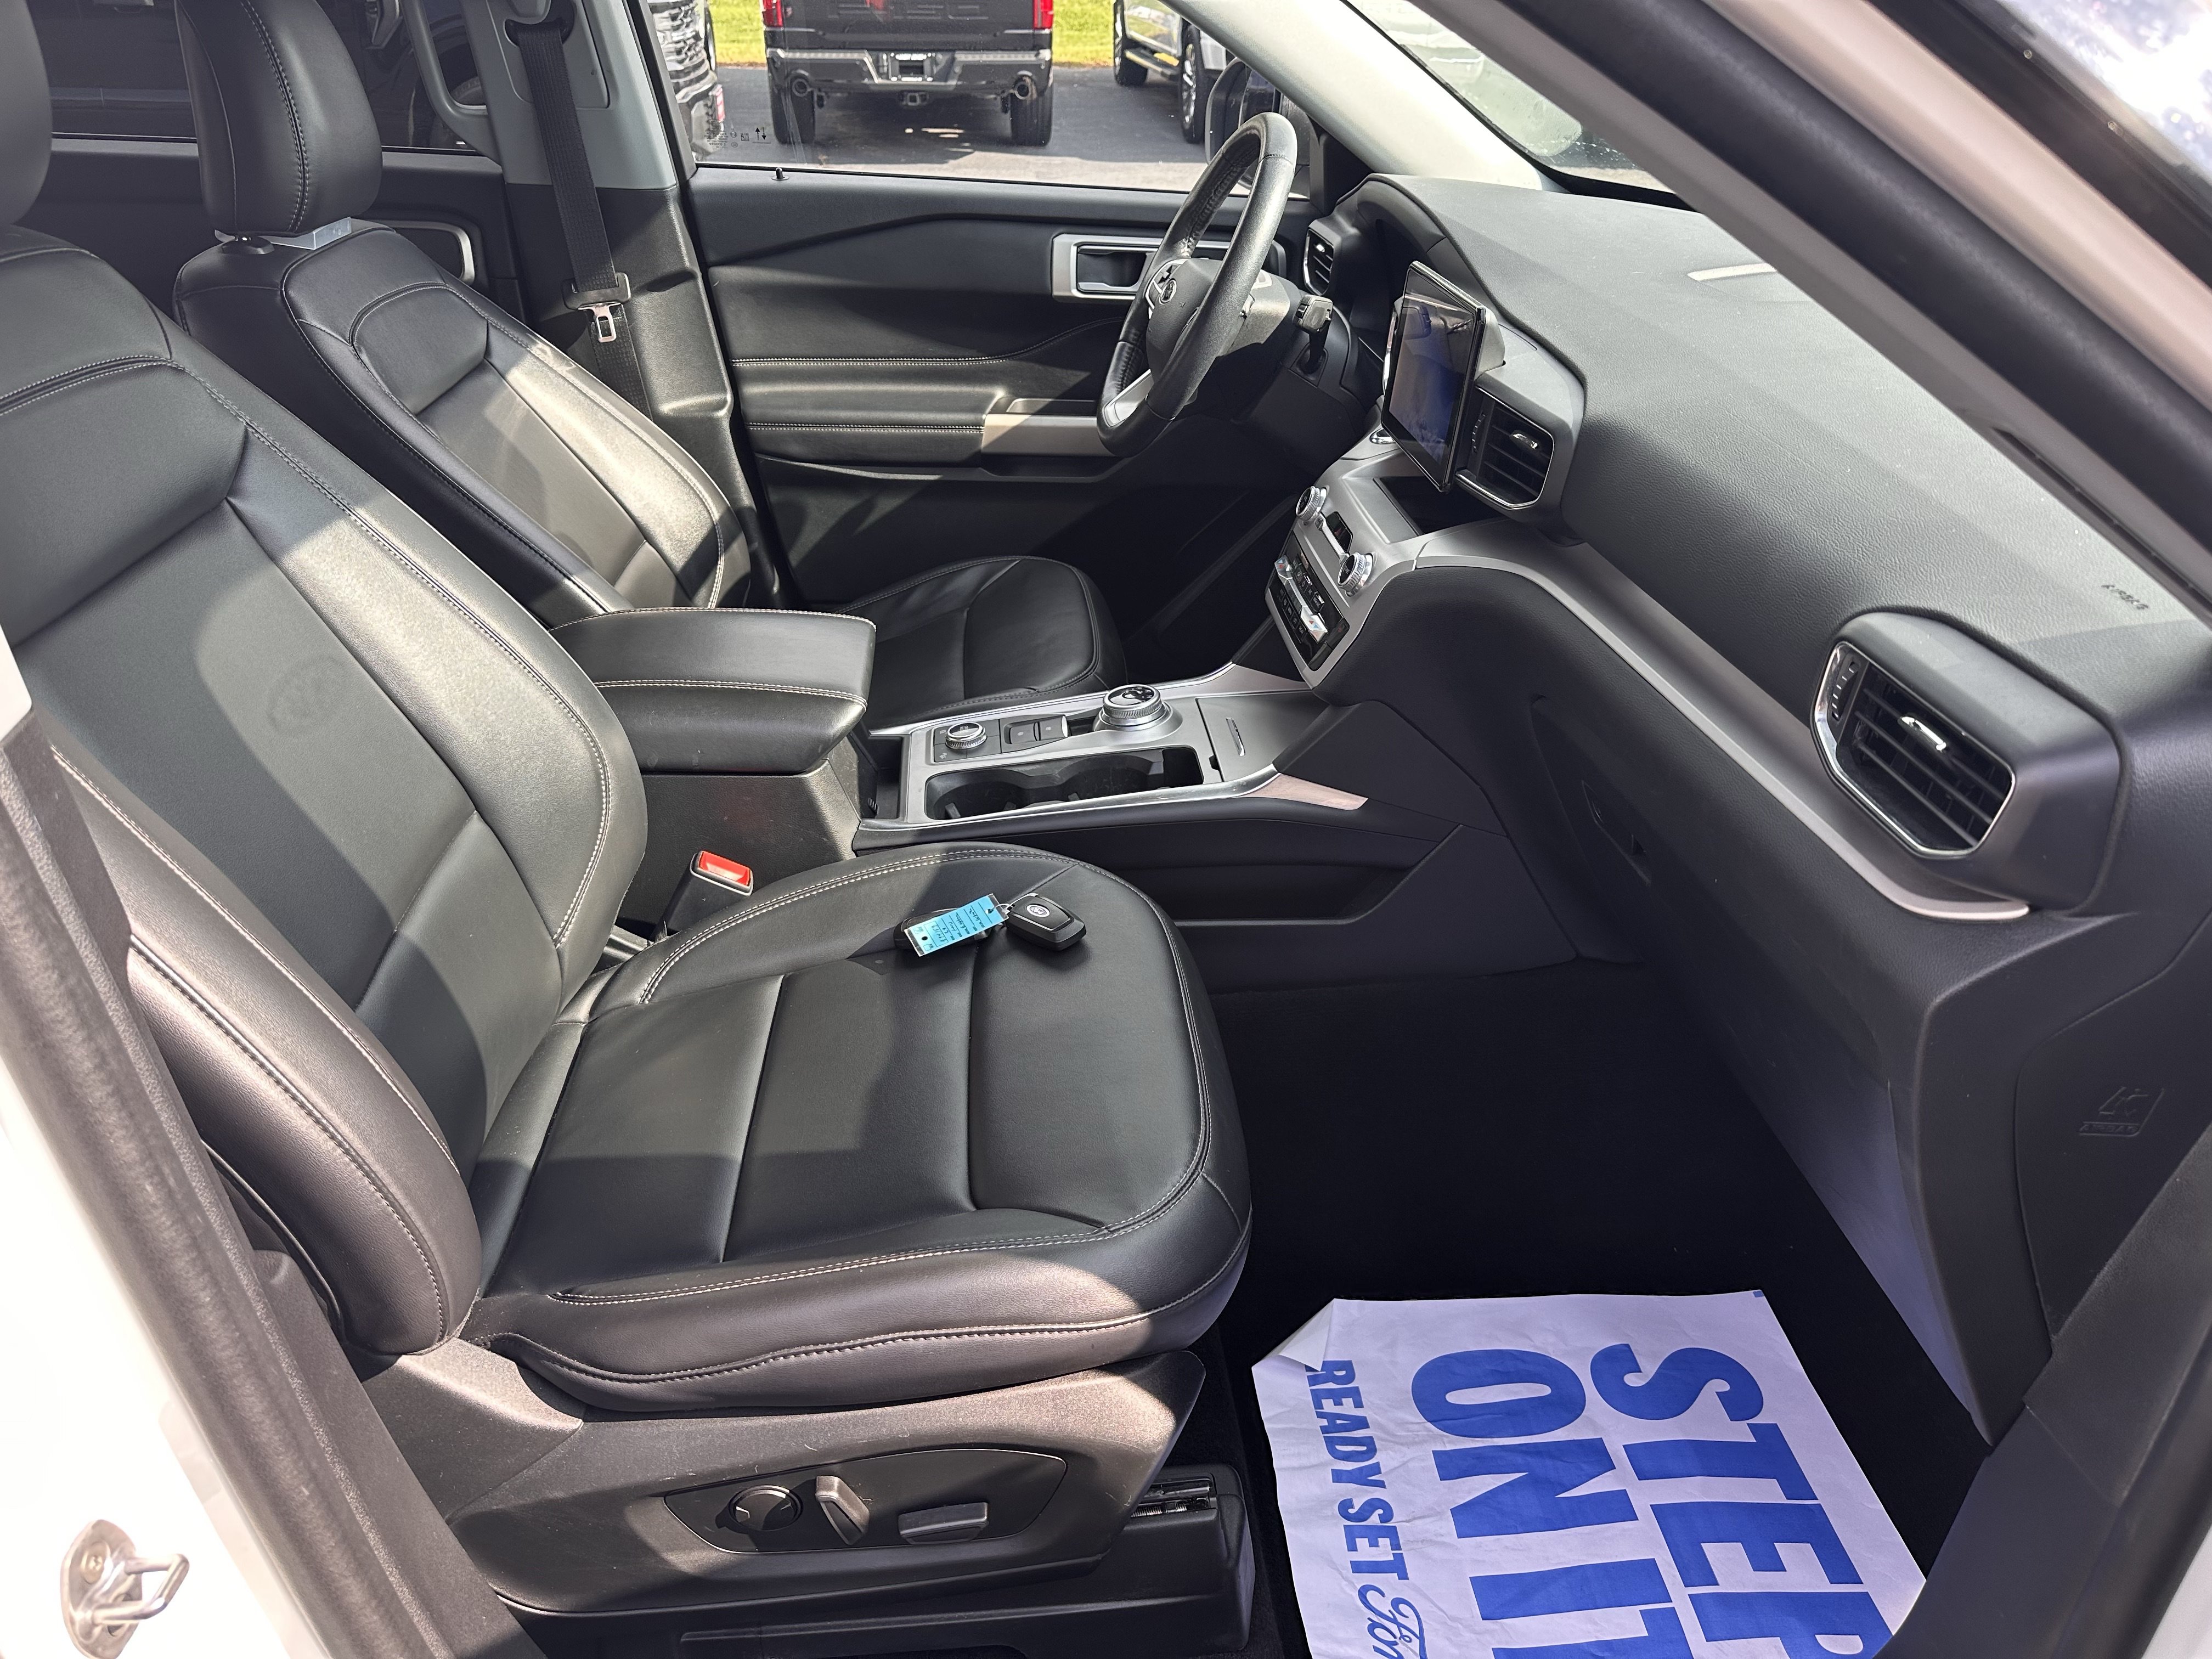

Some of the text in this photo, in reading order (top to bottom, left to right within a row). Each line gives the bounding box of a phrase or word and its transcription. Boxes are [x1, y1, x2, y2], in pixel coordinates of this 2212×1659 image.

[1305, 1359, 1428, 1659] READY SET For
[1411, 1348, 1639, 1539] ON
[1589, 1342, 1894, 1659] STEP
